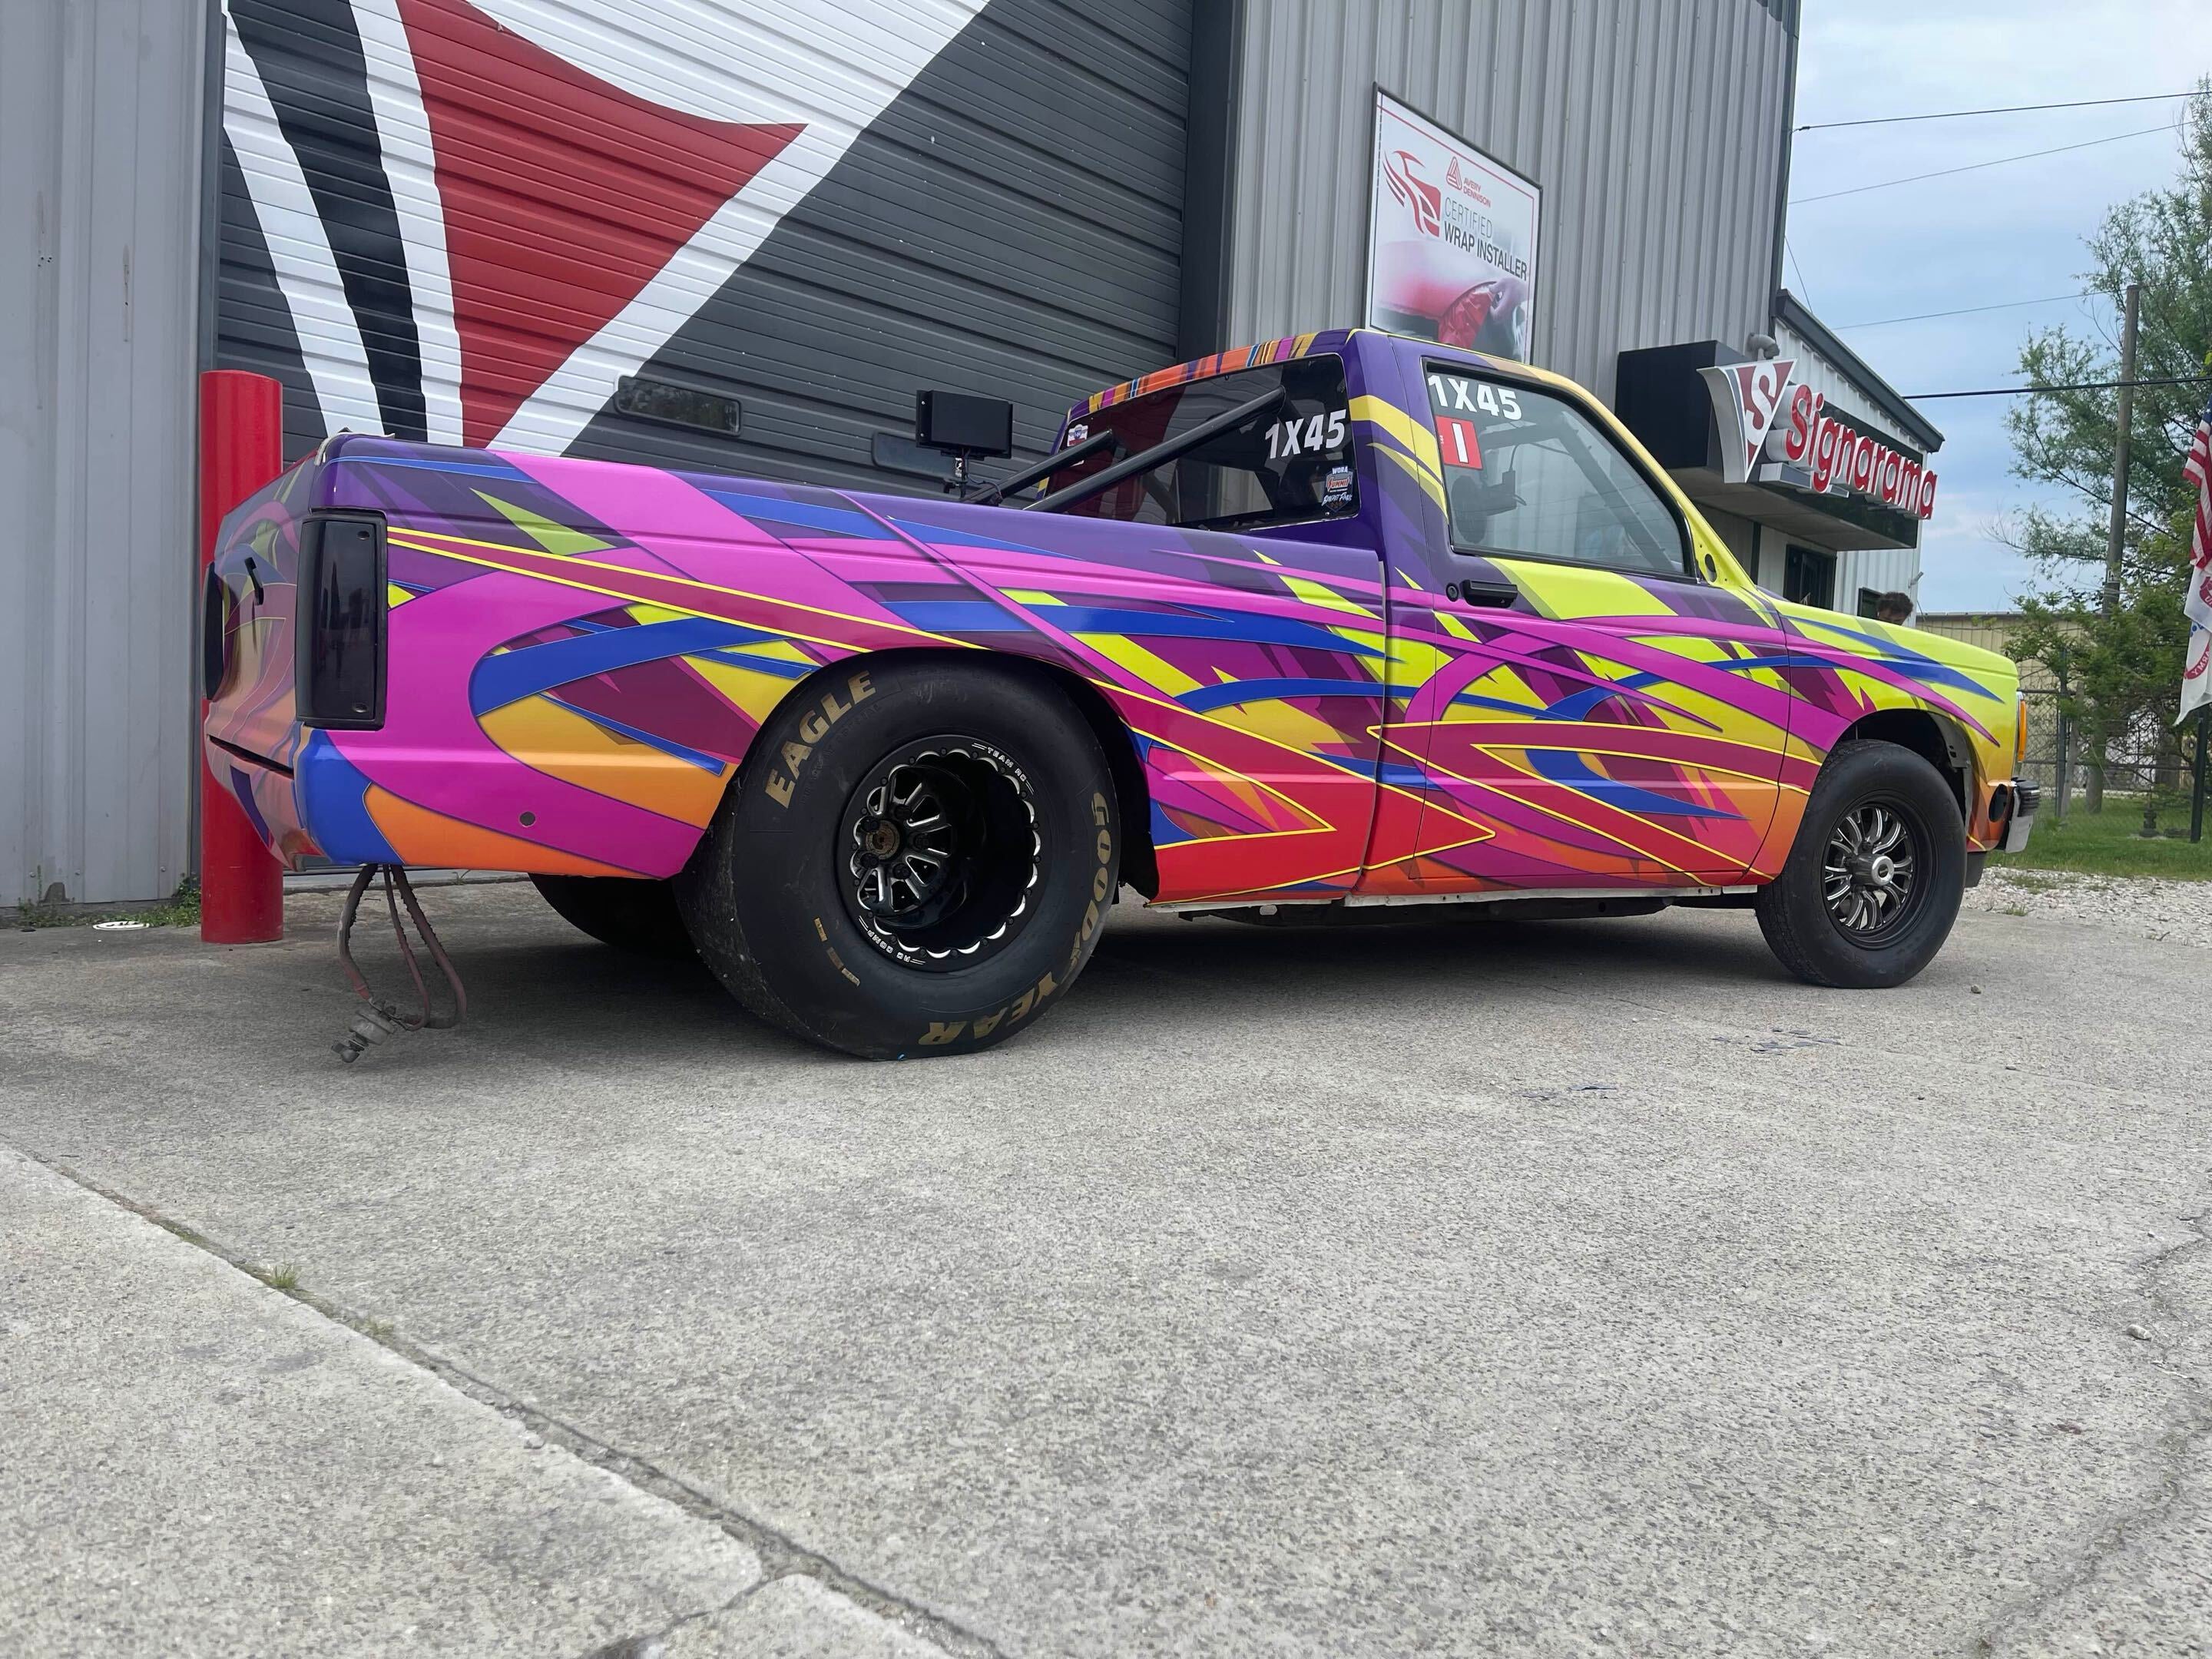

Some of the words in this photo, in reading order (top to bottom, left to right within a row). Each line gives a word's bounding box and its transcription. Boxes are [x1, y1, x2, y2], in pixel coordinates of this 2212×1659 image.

[1462, 186, 1492, 208] DENNISON
[1463, 177, 1482, 193] AVERY
[1444, 197, 1493, 239] CERTIFIED
[1444, 220, 1475, 253] WRAP
[1476, 237, 1527, 281] INSTALLER
[1427, 374, 1522, 421] 1X45
[1264, 409, 1346, 459] 1X45
[1784, 384, 1939, 521] Signarama
[764, 669, 876, 810] EAGLE
[988, 747, 1014, 768] TEAM
[867, 929, 894, 954] COMP
